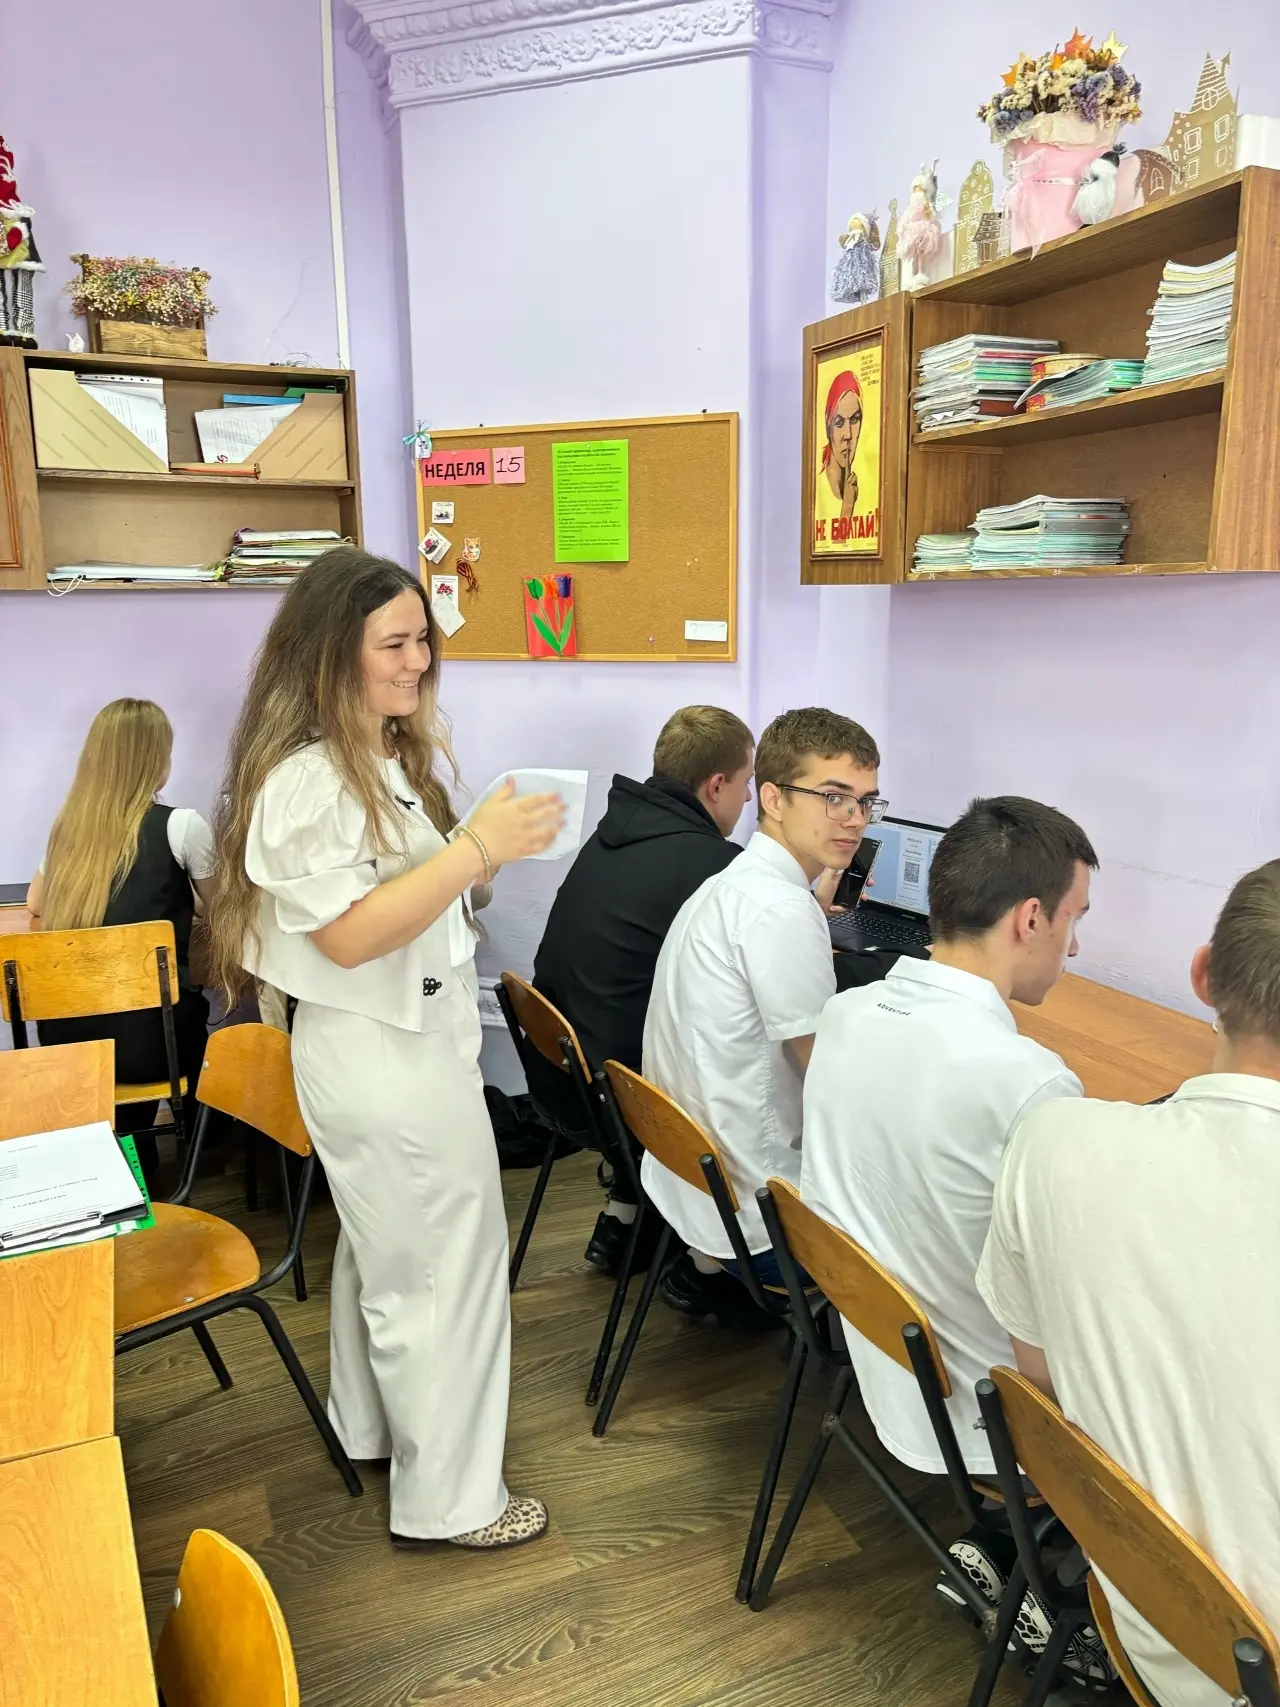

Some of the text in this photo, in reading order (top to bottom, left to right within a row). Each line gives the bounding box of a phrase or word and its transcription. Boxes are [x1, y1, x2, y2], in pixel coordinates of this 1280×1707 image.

[424, 456, 524, 480] НЕДЕЛЯ 15
[815, 508, 880, 541] НЕ БОЛТАЙ!
